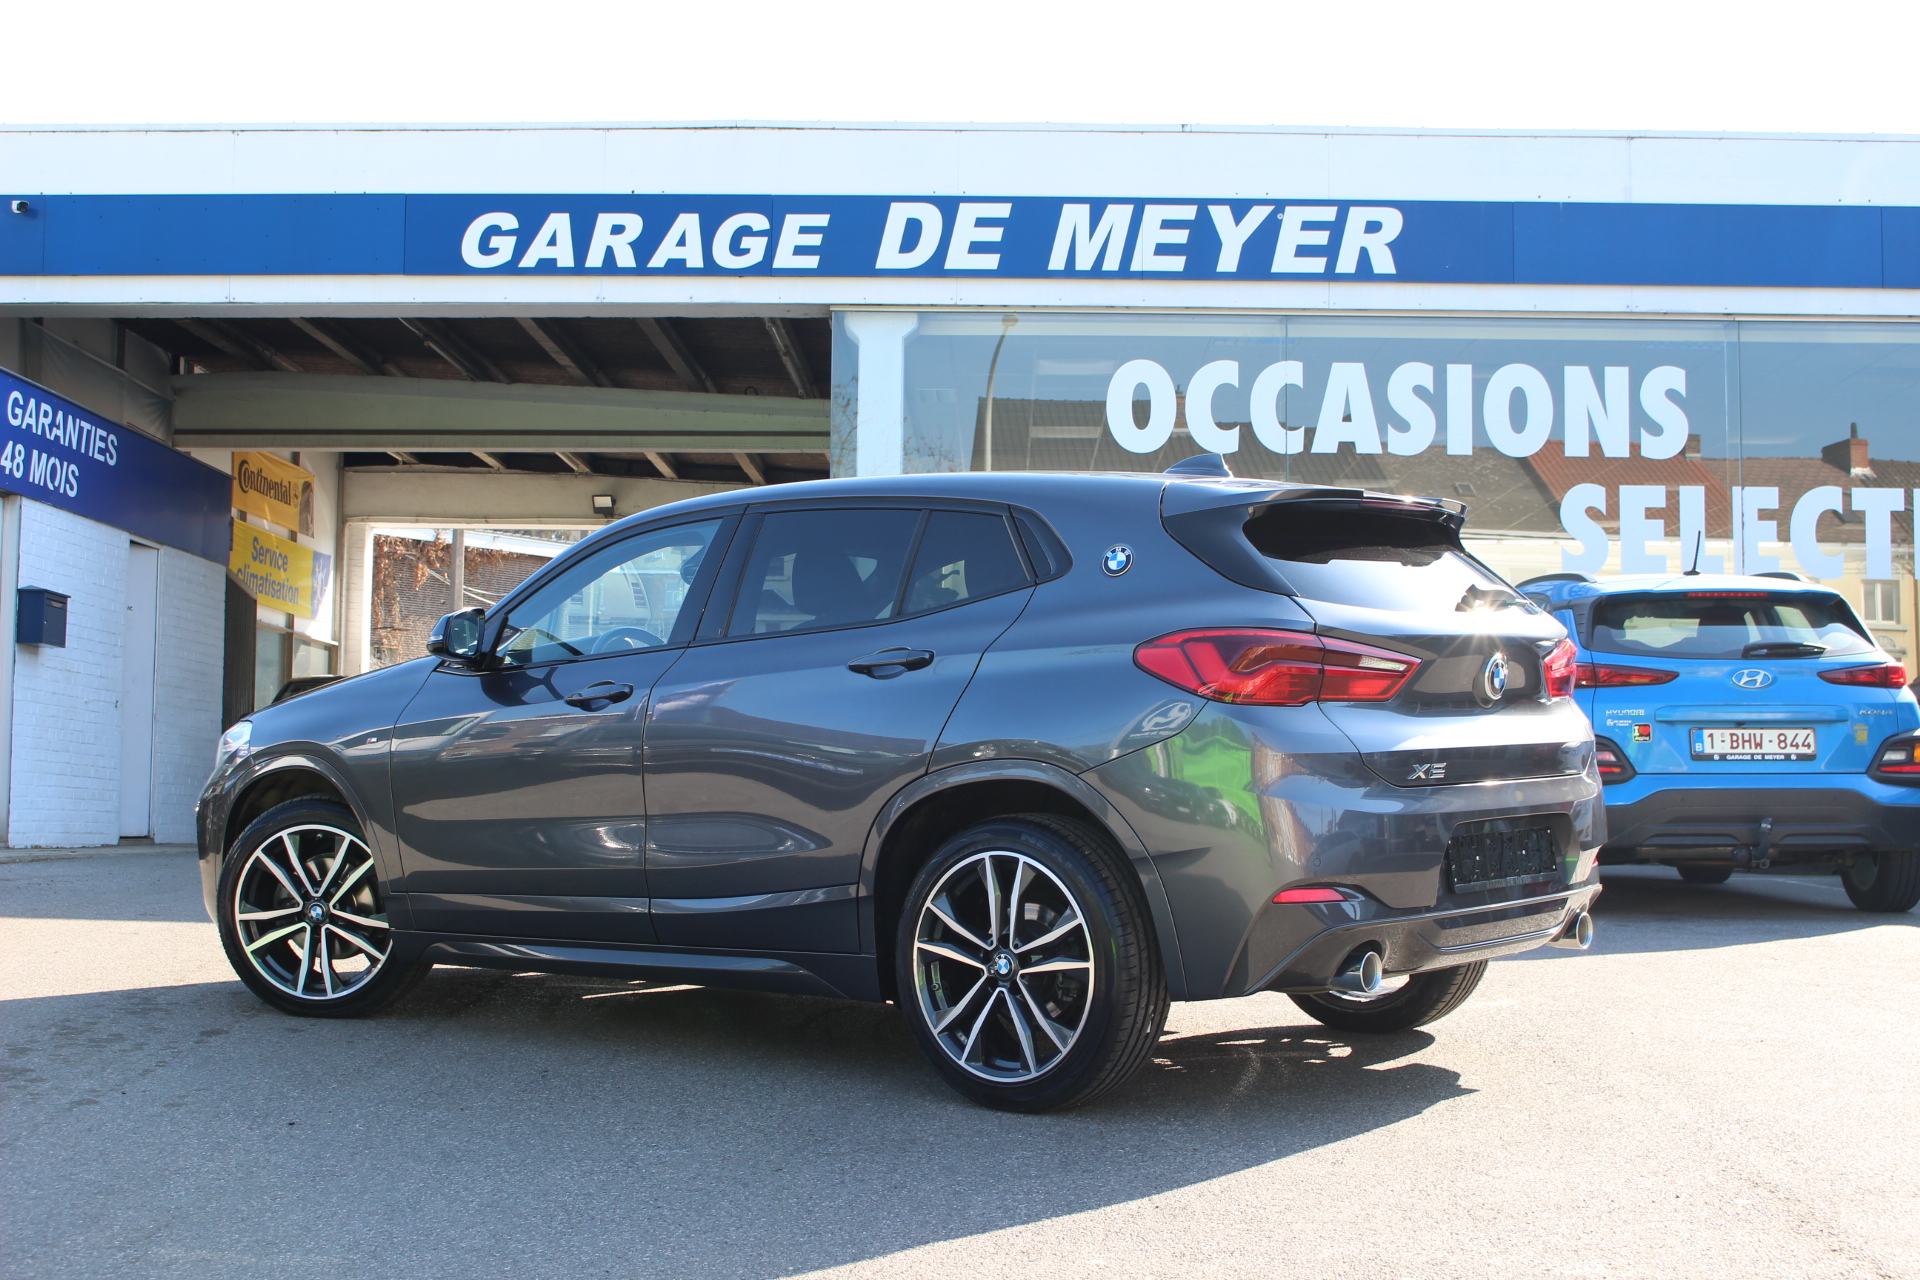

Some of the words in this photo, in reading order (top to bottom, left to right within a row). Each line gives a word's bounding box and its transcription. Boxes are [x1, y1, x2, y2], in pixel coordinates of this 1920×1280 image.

[461, 212, 831, 269] GARAGE
[875, 202, 1012, 270] DE
[1047, 204, 1404, 274] MEYER
[7, 390, 118, 466] GARANTIES
[1106, 358, 1690, 460] OCCASIONS
[0, 440, 25, 479] 48
[29, 449, 79, 498] MOIS
[237, 459, 292, 506] Continental
[251, 536, 289, 573] Service
[1559, 483, 1920, 580] SELECT
